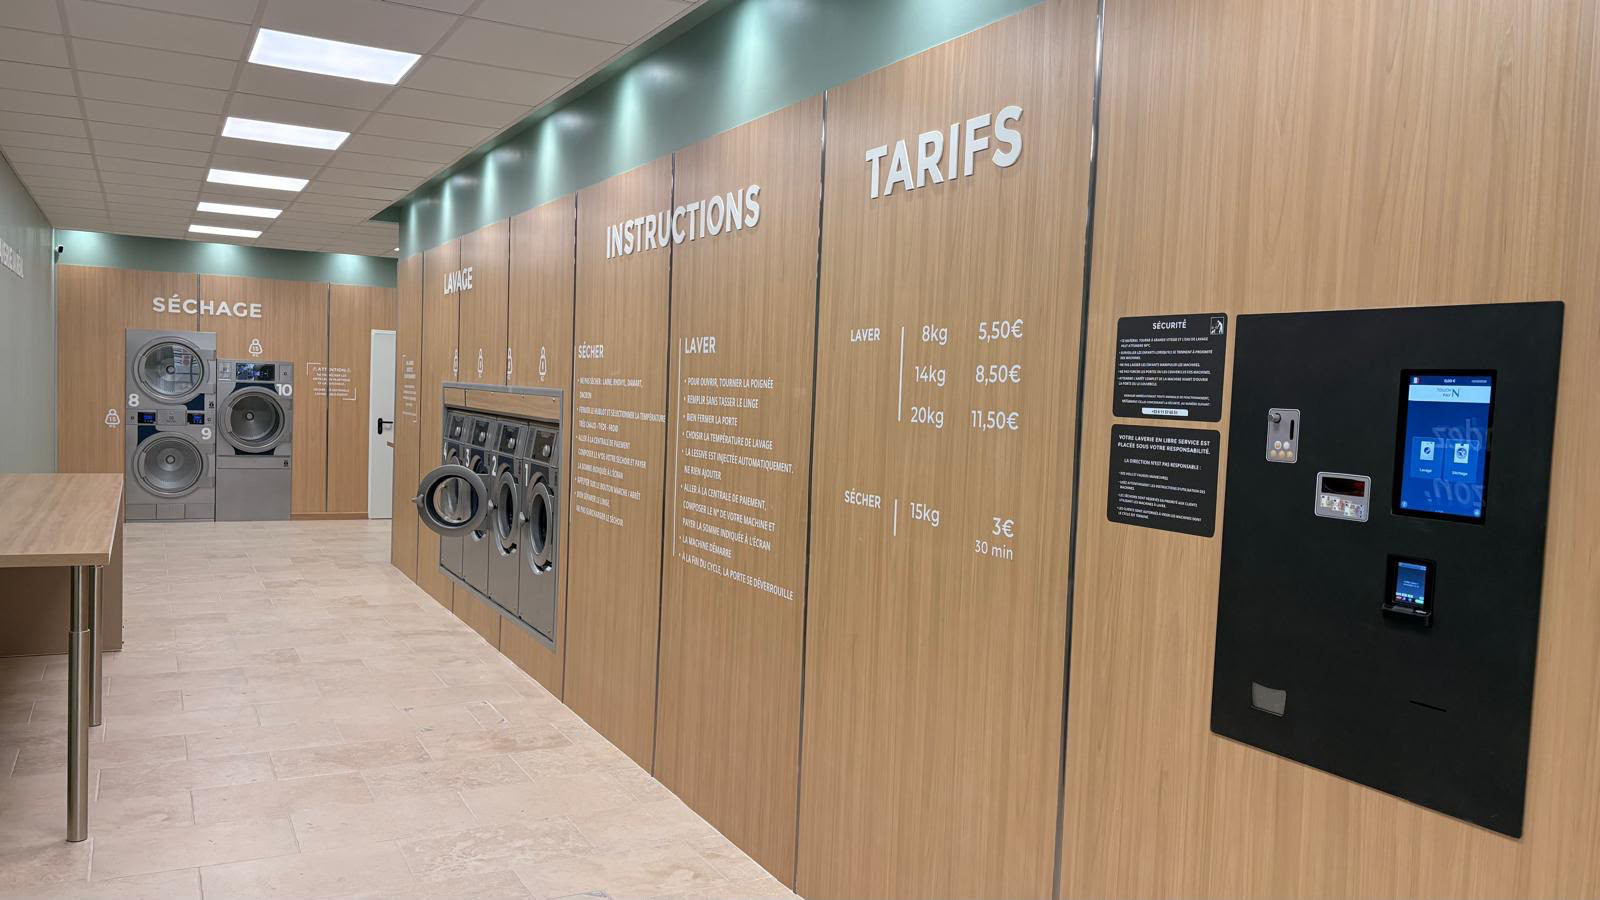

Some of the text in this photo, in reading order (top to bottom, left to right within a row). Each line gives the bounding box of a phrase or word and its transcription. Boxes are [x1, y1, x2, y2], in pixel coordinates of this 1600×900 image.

[866, 106, 1023, 200] TARIFS
[606, 184, 761, 260] INSTRUCTIONS
[444, 266, 472, 295] LAVAGE
[152, 294, 262, 318] SÉCHAGE
[850, 319, 1024, 346] LAVER 8kg 5,50€
[1152, 319, 1187, 330] SÉCURITÉ
[578, 341, 604, 359] SÉCHER
[684, 336, 716, 354] LAVER
[743, 379, 750, 388] LA
[750, 376, 774, 389] POIGNÉE
[914, 364, 1022, 388] 14kg 8,50€
[128, 394, 140, 407] 8
[276, 384, 292, 396] 10
[736, 398, 742, 408] LE
[743, 398, 759, 409] LINGE
[715, 415, 721, 424] LA
[722, 416, 738, 426] PORTE
[910, 406, 1019, 432] 20kg 11,50€
[201, 427, 212, 440] 9
[686, 431, 773, 450] CHOISIR LA TEMPÉRATURE DE LAVAGE
[466, 449, 470, 467] 3
[1166, 445, 1211, 455] RESPONSABILITÉ.
[491, 455, 496, 476] 2
[685, 448, 691, 456] LA
[717, 451, 738, 464] INJECTÉE
[738, 456, 794, 474] AUTOMATIQUEMENT.
[525, 463, 528, 487] 1
[684, 465, 690, 473] NE
[702, 468, 721, 480] AJOUTER
[684, 484, 767, 511] ALLER À LA CENTRALE DE PAIEMENT,
[844, 488, 940, 527] SÉCHER 15kg
[683, 500, 776, 532] COMPOSER LE N° DE VOTRE MACHINE ET
[682, 517, 771, 552] PAYER LA SOMME INDIQUÉE À L'ÉCRAN
[992, 517, 1014, 538] 3€
[682, 535, 732, 559] LA MACHINE DÉMARRE
[974, 539, 1014, 560] 30 min
[685, 554, 691, 563] LA
[700, 559, 707, 569] DU
[707, 562, 723, 576] CYCLE,
[723, 568, 729, 578] LA
[730, 570, 746, 583] PORTE
[746, 576, 753, 586] SE
[753, 577, 794, 602] DÉVERROUILLE
